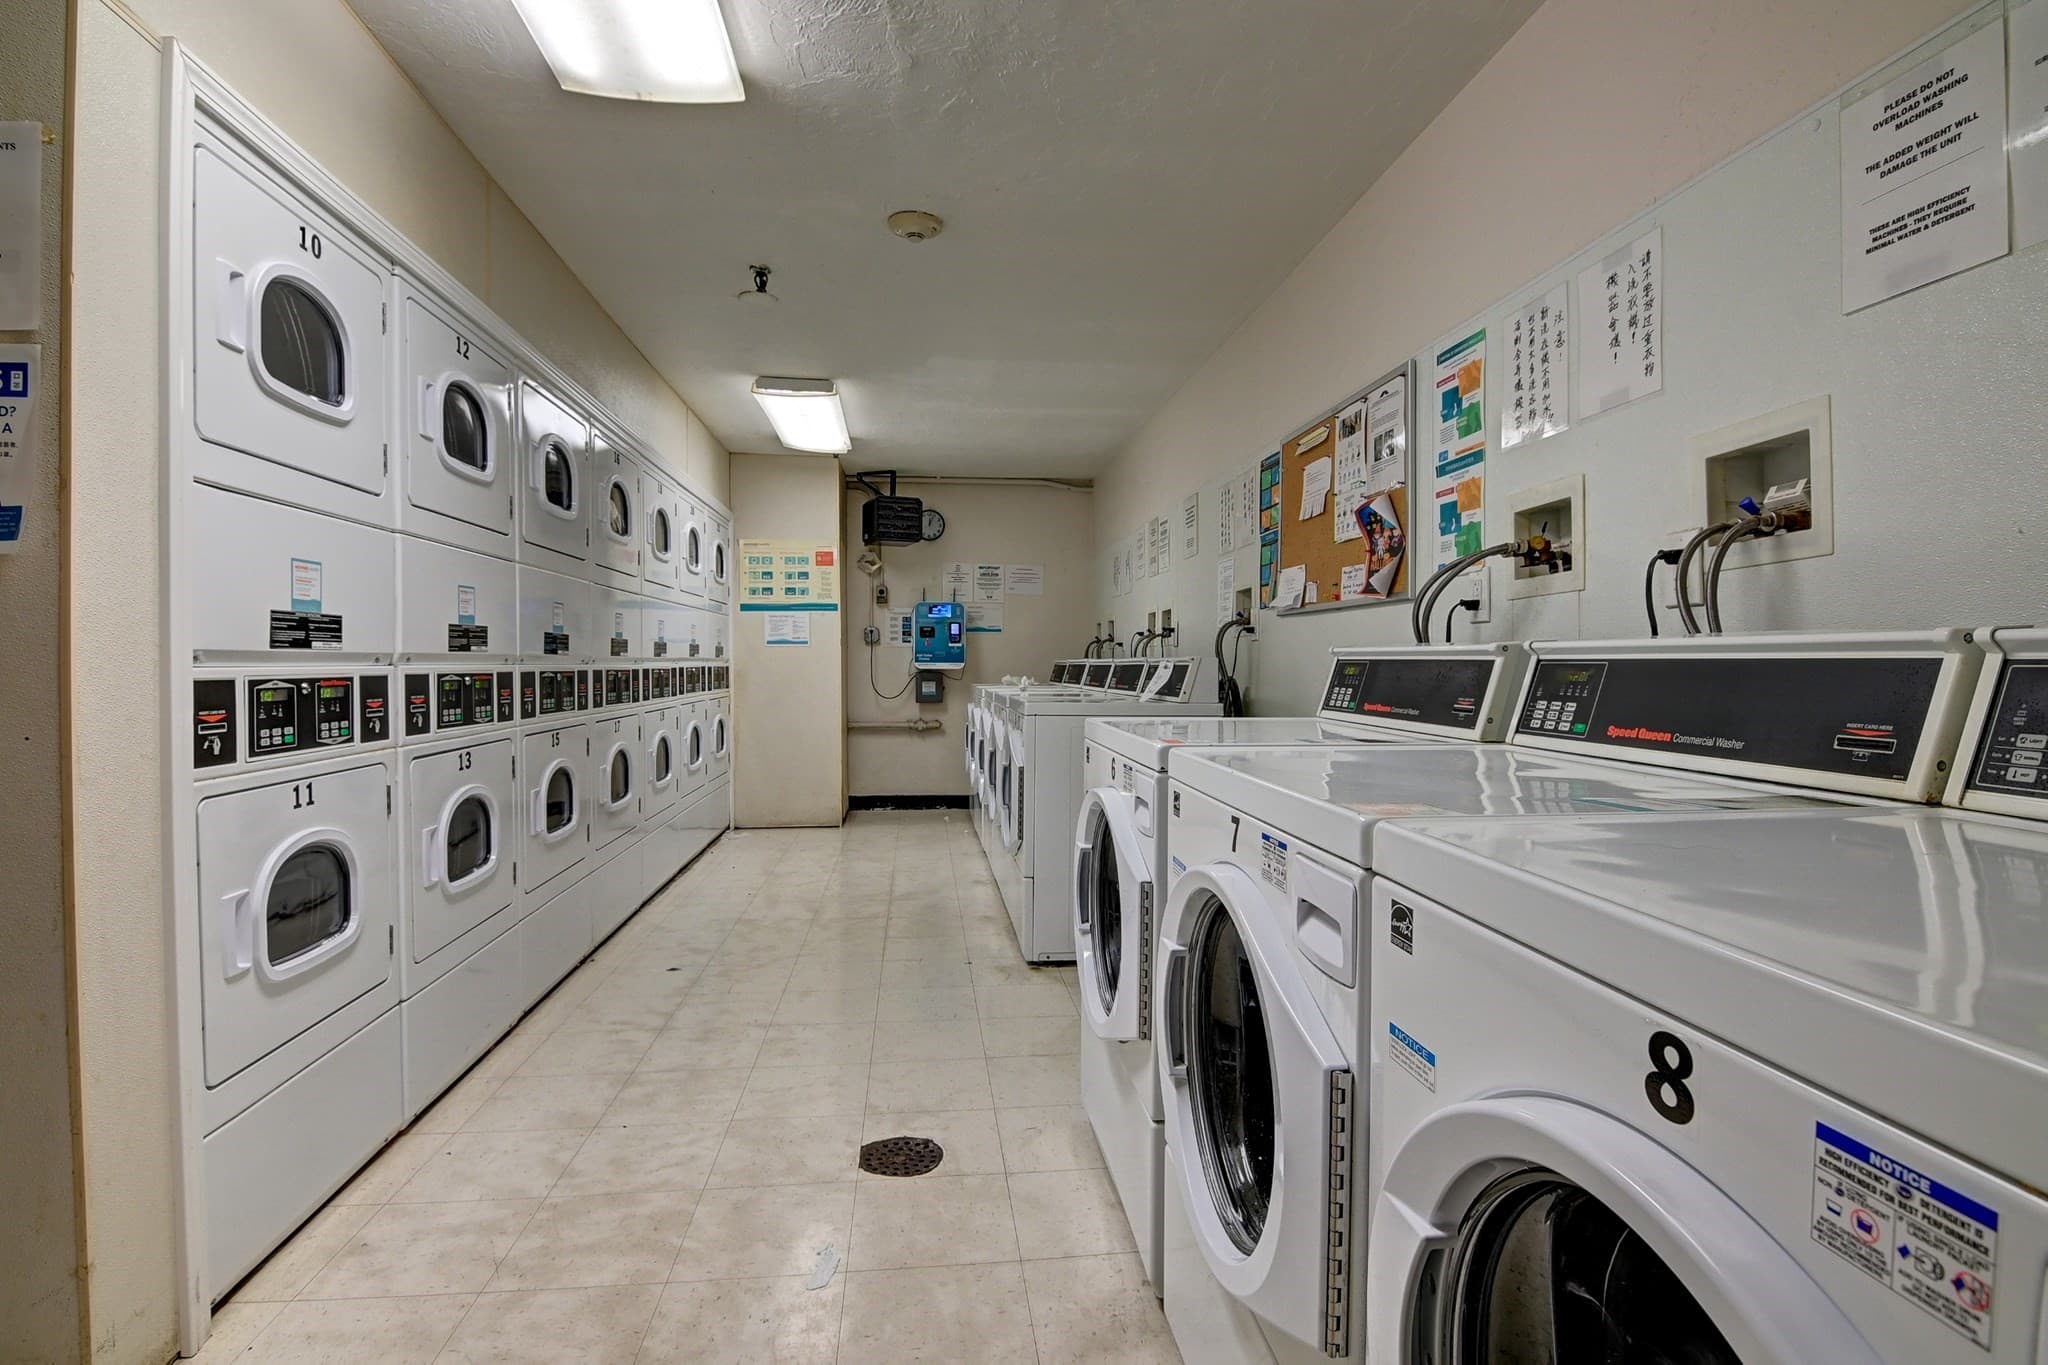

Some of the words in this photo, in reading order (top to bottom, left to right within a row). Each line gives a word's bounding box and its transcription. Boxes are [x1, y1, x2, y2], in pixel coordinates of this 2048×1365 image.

[1872, 101, 1920, 131] OVERLOAD
[1922, 74, 1968, 104] WASHING
[1884, 89, 1919, 113] PLEASE
[1920, 81, 1933, 93] DO
[1936, 68, 1955, 84] NOT
[1895, 100, 1944, 131] MACHINES
[1865, 161, 1881, 174] THE
[1883, 145, 1913, 165] ADDED
[1916, 124, 1952, 149] WEIGHT
[1954, 112, 1979, 129] WILL
[1880, 154, 1918, 179] DAMAGE
[1920, 144, 1938, 159] THE
[1940, 132, 1962, 149] UNIT
[1866, 238, 1896, 255] MINIMAL
[1897, 226, 1922, 241] WATER
[1931, 204, 1976, 227] DETERGENT
[1869, 221, 1890, 235] THESE
[1892, 214, 1906, 225] ARE
[1907, 205, 1925, 218] HIGH
[1927, 186, 1970, 211] EFFICIENCY
[1872, 223, 1908, 243] MACHINES
[1914, 212, 1932, 225] THEY
[1933, 197, 1967, 216] REQUIRE
[300, 226, 321, 259] 10
[456, 336, 469, 360] 12
[2, 422, 13, 434] A
[552, 732, 560, 747] 15
[614, 720, 620, 734] 17
[1607, 725, 1638, 739] Speed
[1638, 728, 1671, 742] Queen
[1673, 733, 1715, 746] Commercial
[1716, 737, 1744, 750] Washer
[459, 752, 472, 771] 13
[1112, 757, 1116, 780] 6
[293, 782, 315, 809] 11
[1231, 815, 1240, 853] 7
[1395, 1028, 1432, 1062] NOTICE
[1645, 1031, 1694, 1125] 8
[1869, 1152, 1931, 1194] NOTICE
[1819, 1156, 1877, 1196] RECOMMENDED
[1879, 1187, 1896, 1205] FOR
[1898, 1200, 1918, 1219] BEST
[1922, 1212, 1990, 1258] PERFORMANCE
[1824, 1147, 1842, 1163] HIGH
[1844, 1155, 1889, 1187] EFFICIENCY
[1920, 1197, 1971, 1233] DETERGENT
[1975, 1225, 1983, 1239] IS
